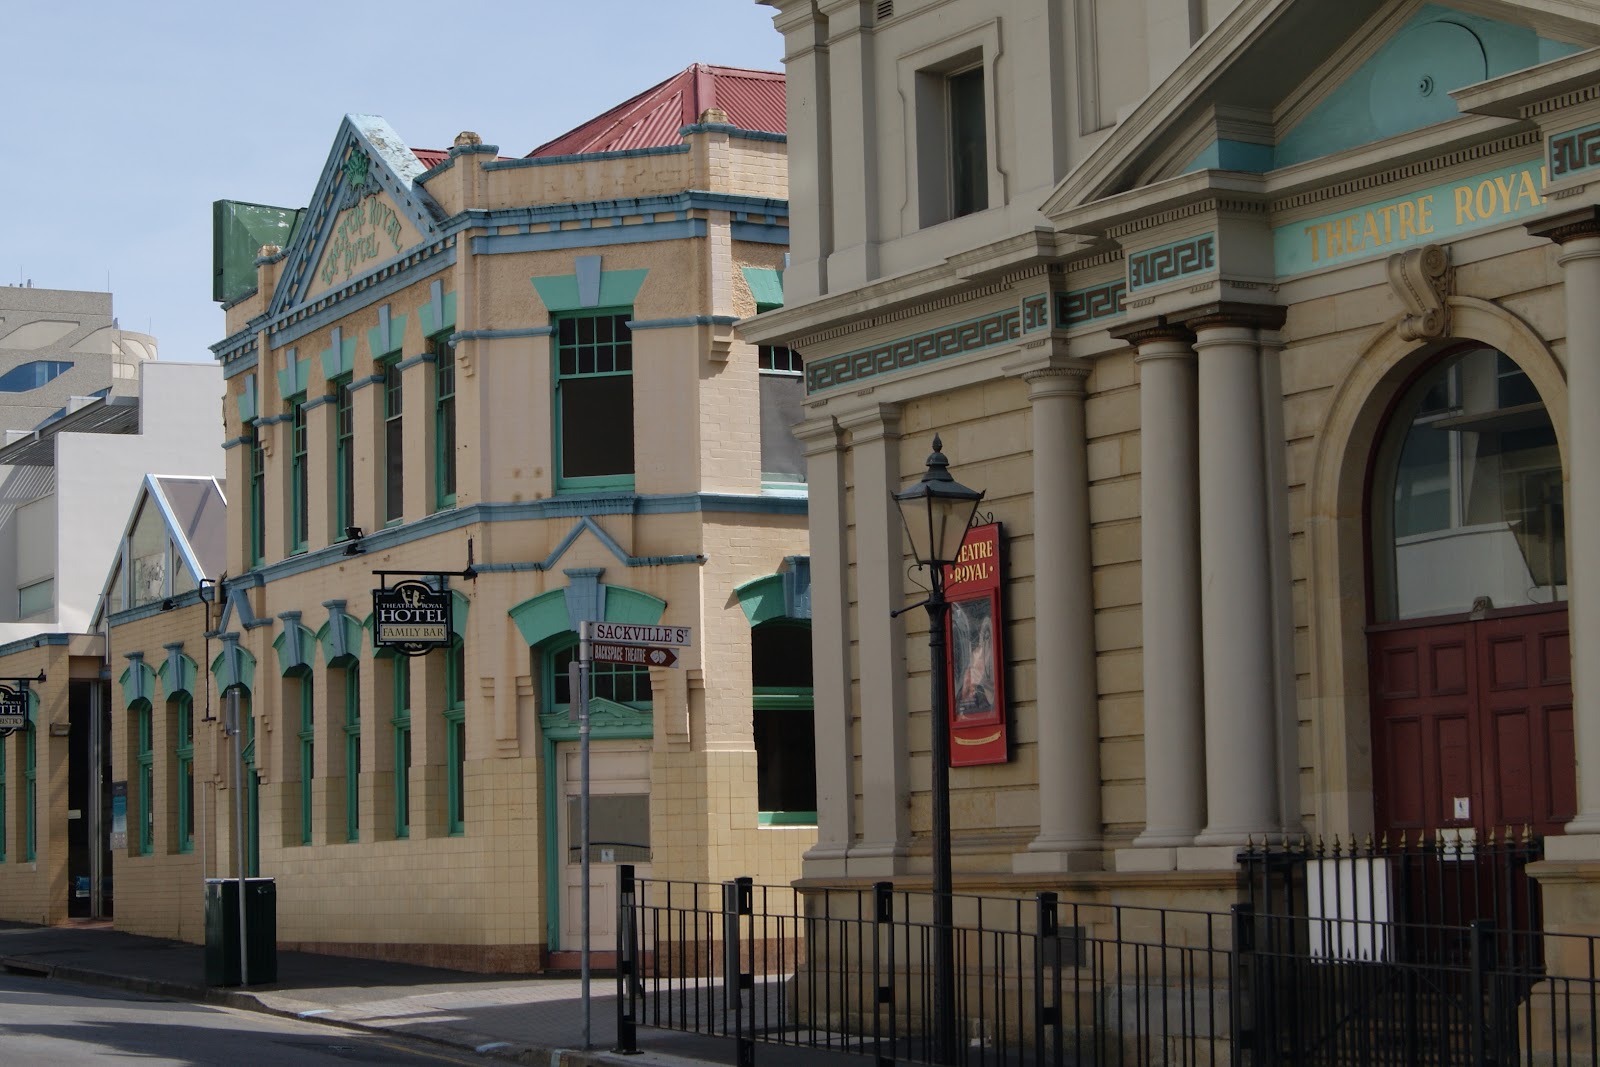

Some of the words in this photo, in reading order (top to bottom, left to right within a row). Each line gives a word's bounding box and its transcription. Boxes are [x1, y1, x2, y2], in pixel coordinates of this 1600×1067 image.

[367, 197, 403, 254] ROYAL
[1304, 195, 1434, 263] THEATRE
[343, 231, 380, 280] HOTEL
[957, 540, 993, 563] EATRE
[954, 562, 989, 583] ROYAL
[380, 609, 447, 623] HOTEL
[383, 627, 420, 637] FAMILY
[423, 627, 444, 637] BAR
[597, 624, 672, 643] SACKVILLE
[676, 629, 689, 643] ST
[594, 644, 623, 661] BACKSPACE
[625, 647, 646, 663] THEATRE
[0, 705, 24, 715] TEL
